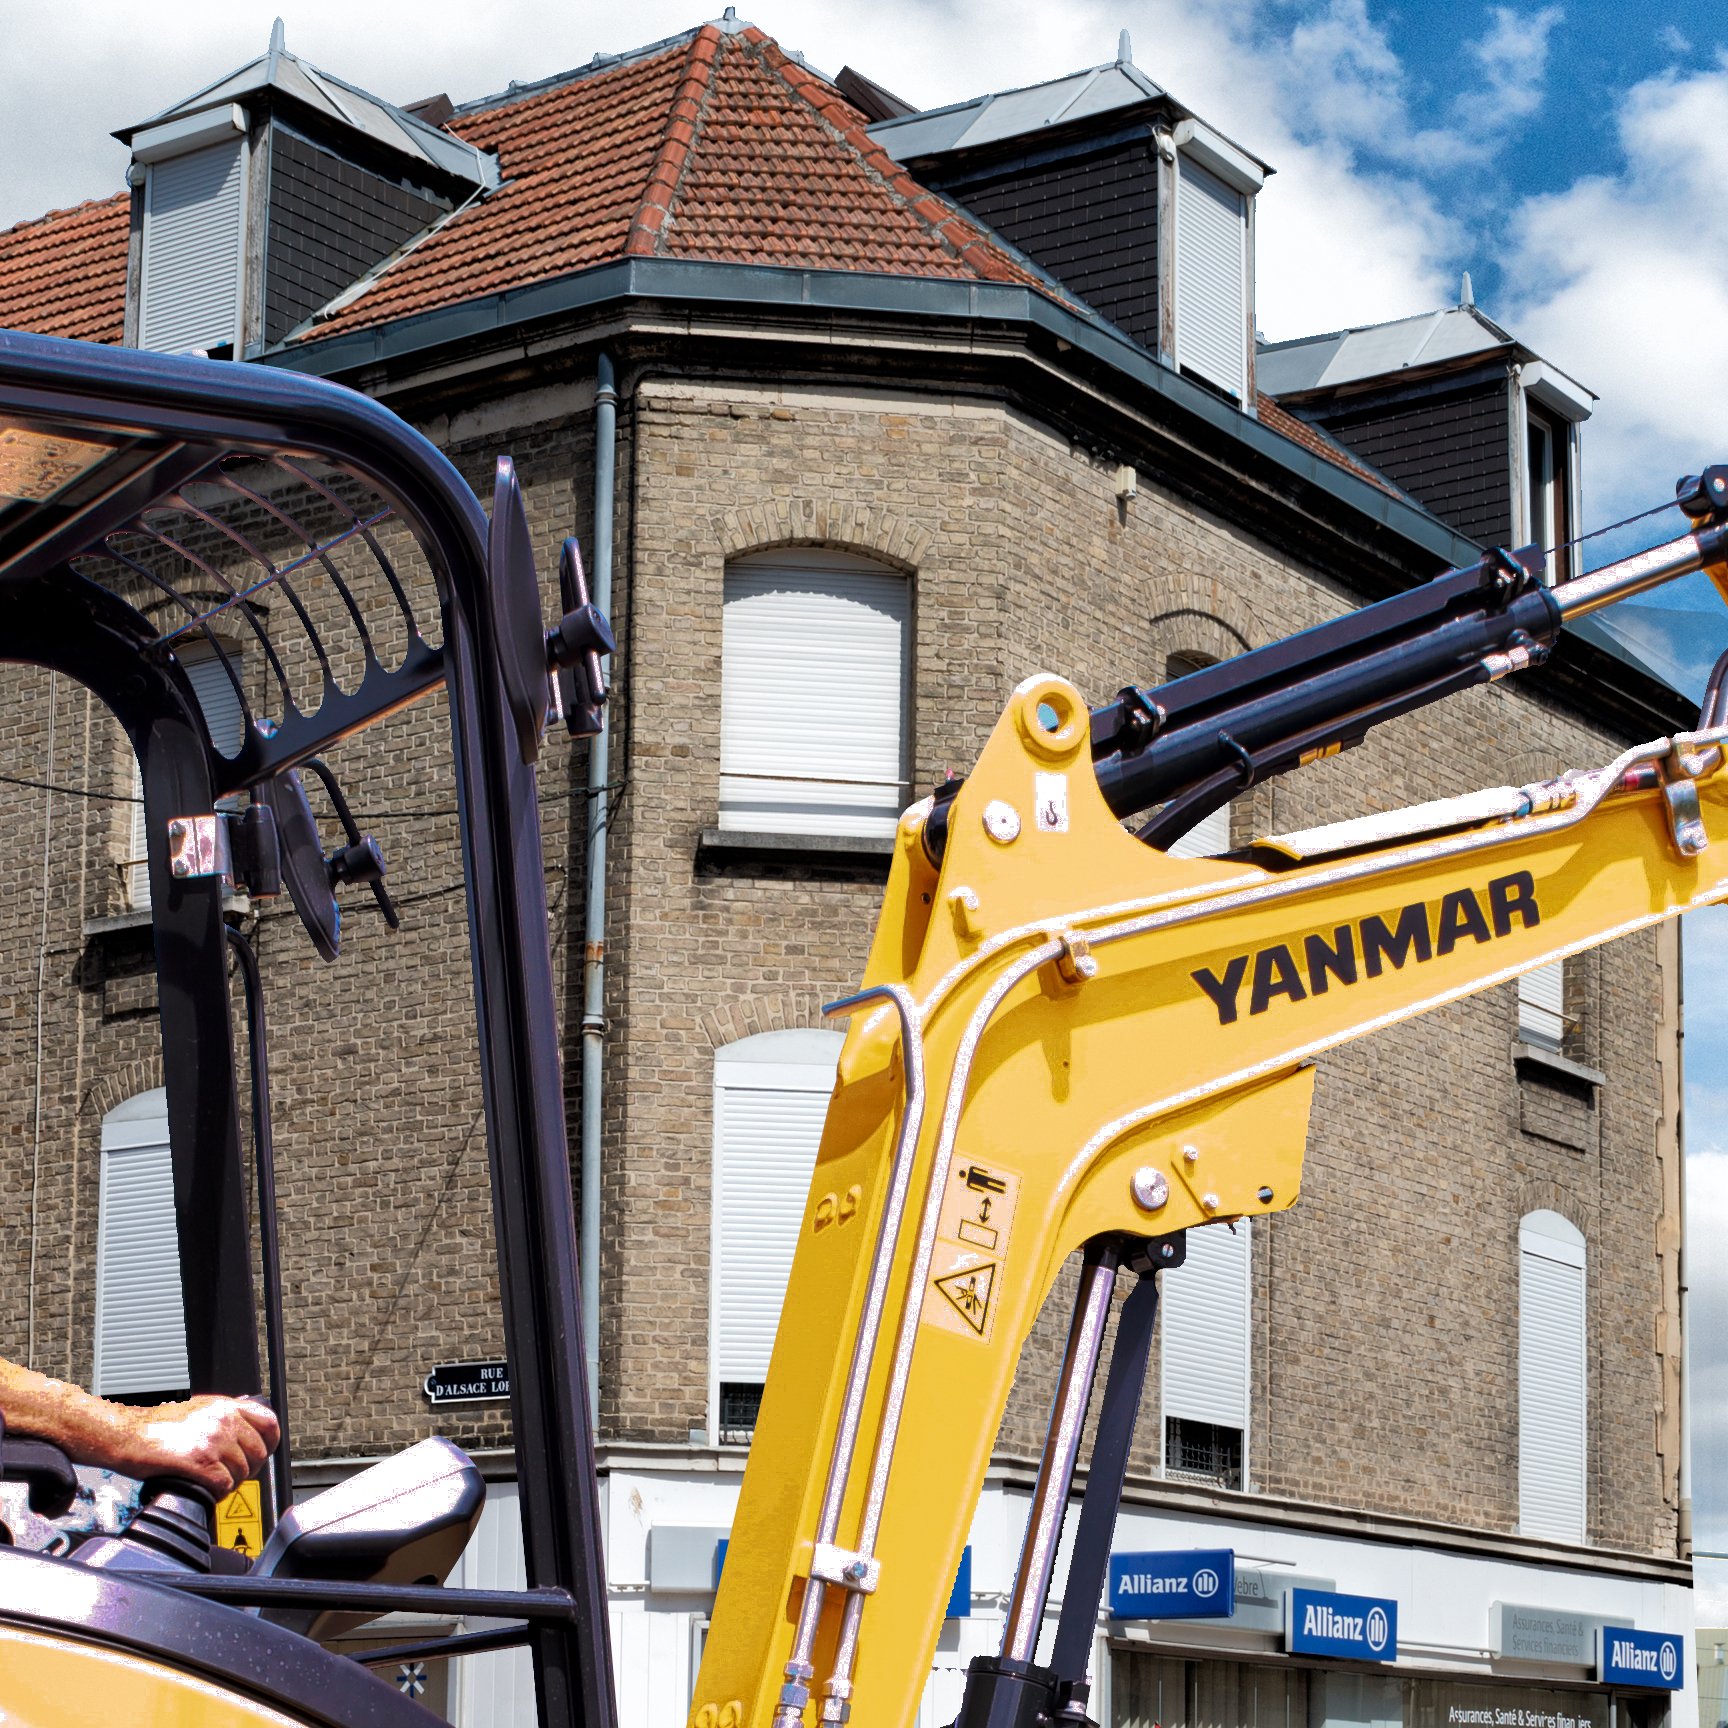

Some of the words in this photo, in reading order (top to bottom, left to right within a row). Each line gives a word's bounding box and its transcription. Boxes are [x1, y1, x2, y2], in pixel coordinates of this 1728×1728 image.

[1190, 870, 1541, 1026] YANMAR
[480, 1367, 504, 1380] RUE
[435, 1382, 487, 1397] D'ALSACE
[1118, 1573, 1188, 1595] Allianz
[1303, 1604, 1363, 1641] Allianz
[1610, 1640, 1658, 1673] Allianz
[1495, 1707, 1516, 1726] Santé
[1518, 1711, 1524, 1726] &
